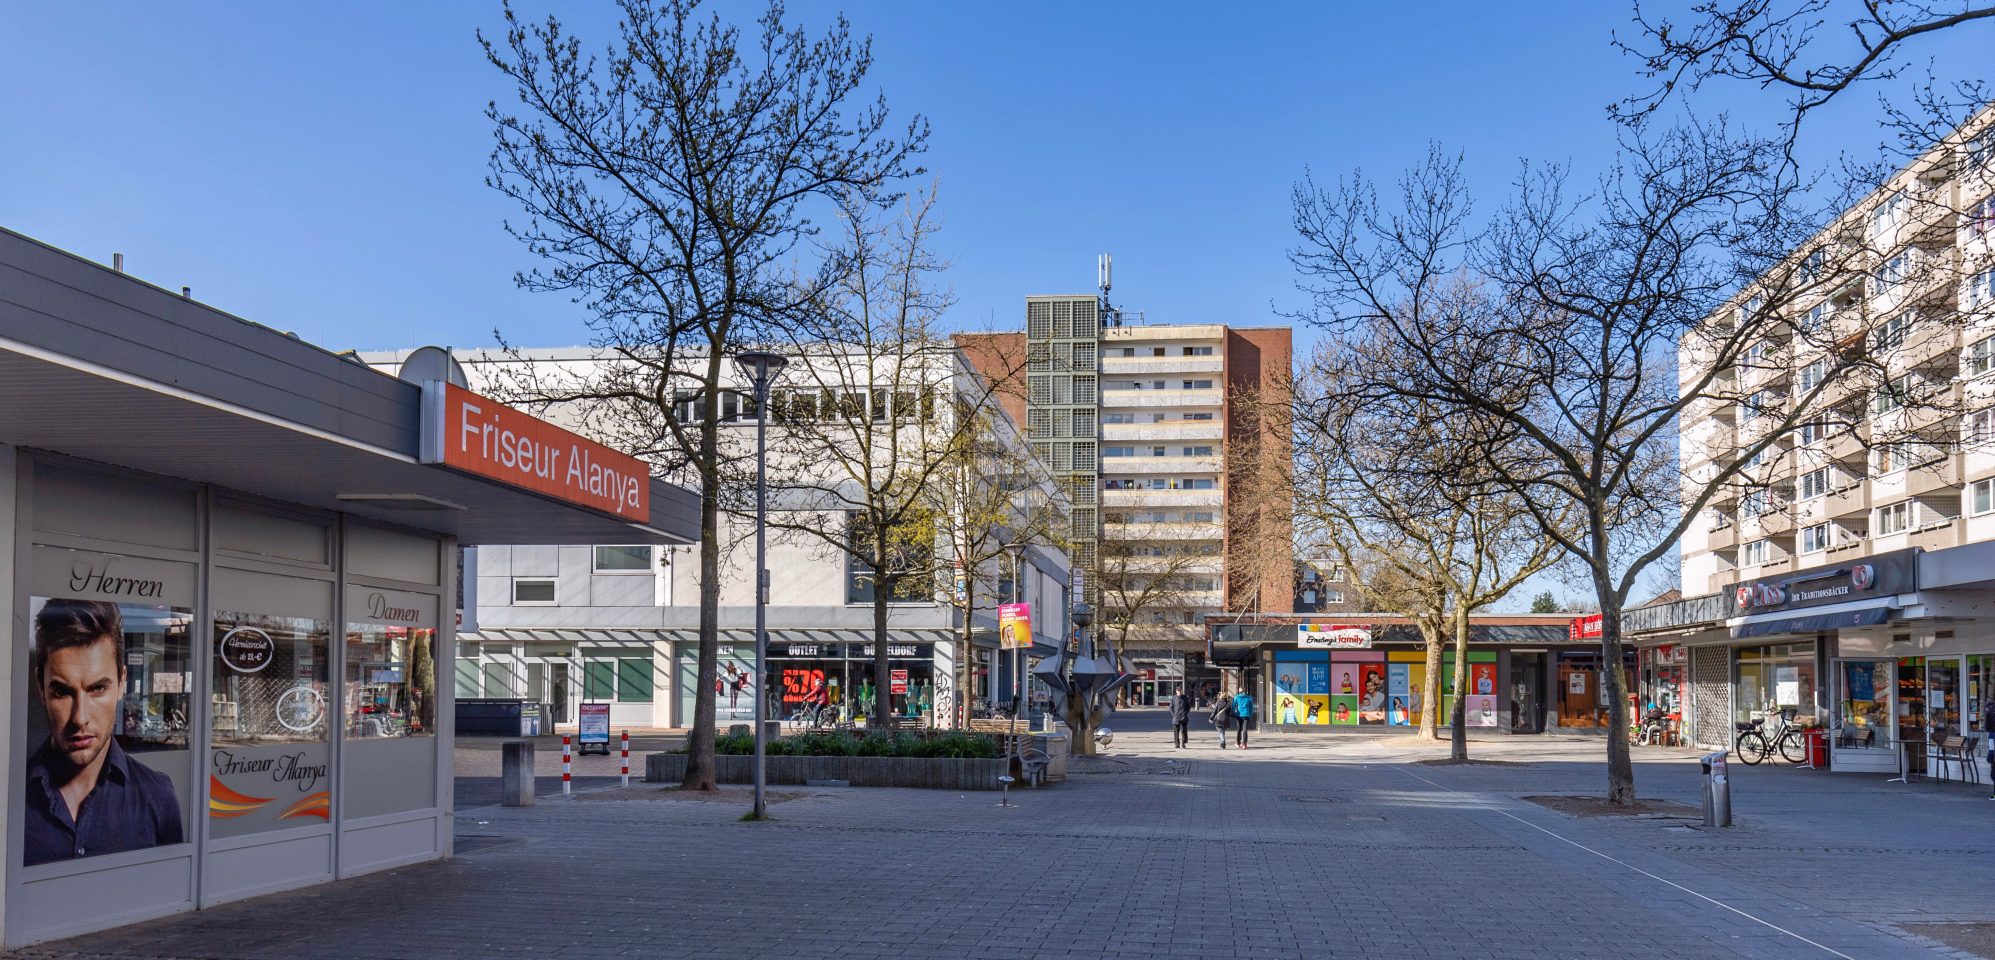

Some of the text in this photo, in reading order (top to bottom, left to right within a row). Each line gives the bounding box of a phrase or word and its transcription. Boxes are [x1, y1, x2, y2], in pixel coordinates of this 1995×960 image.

[462, 401, 639, 513] Friseur Alanya
[70, 563, 162, 598] Herren
[368, 592, 420, 622] Damen
[788, 645, 819, 656] OUTLET
[864, 645, 917, 656] DÜELDORF
[1338, 635, 1364, 645] family
[213, 750, 328, 793] Friseur Alanya
